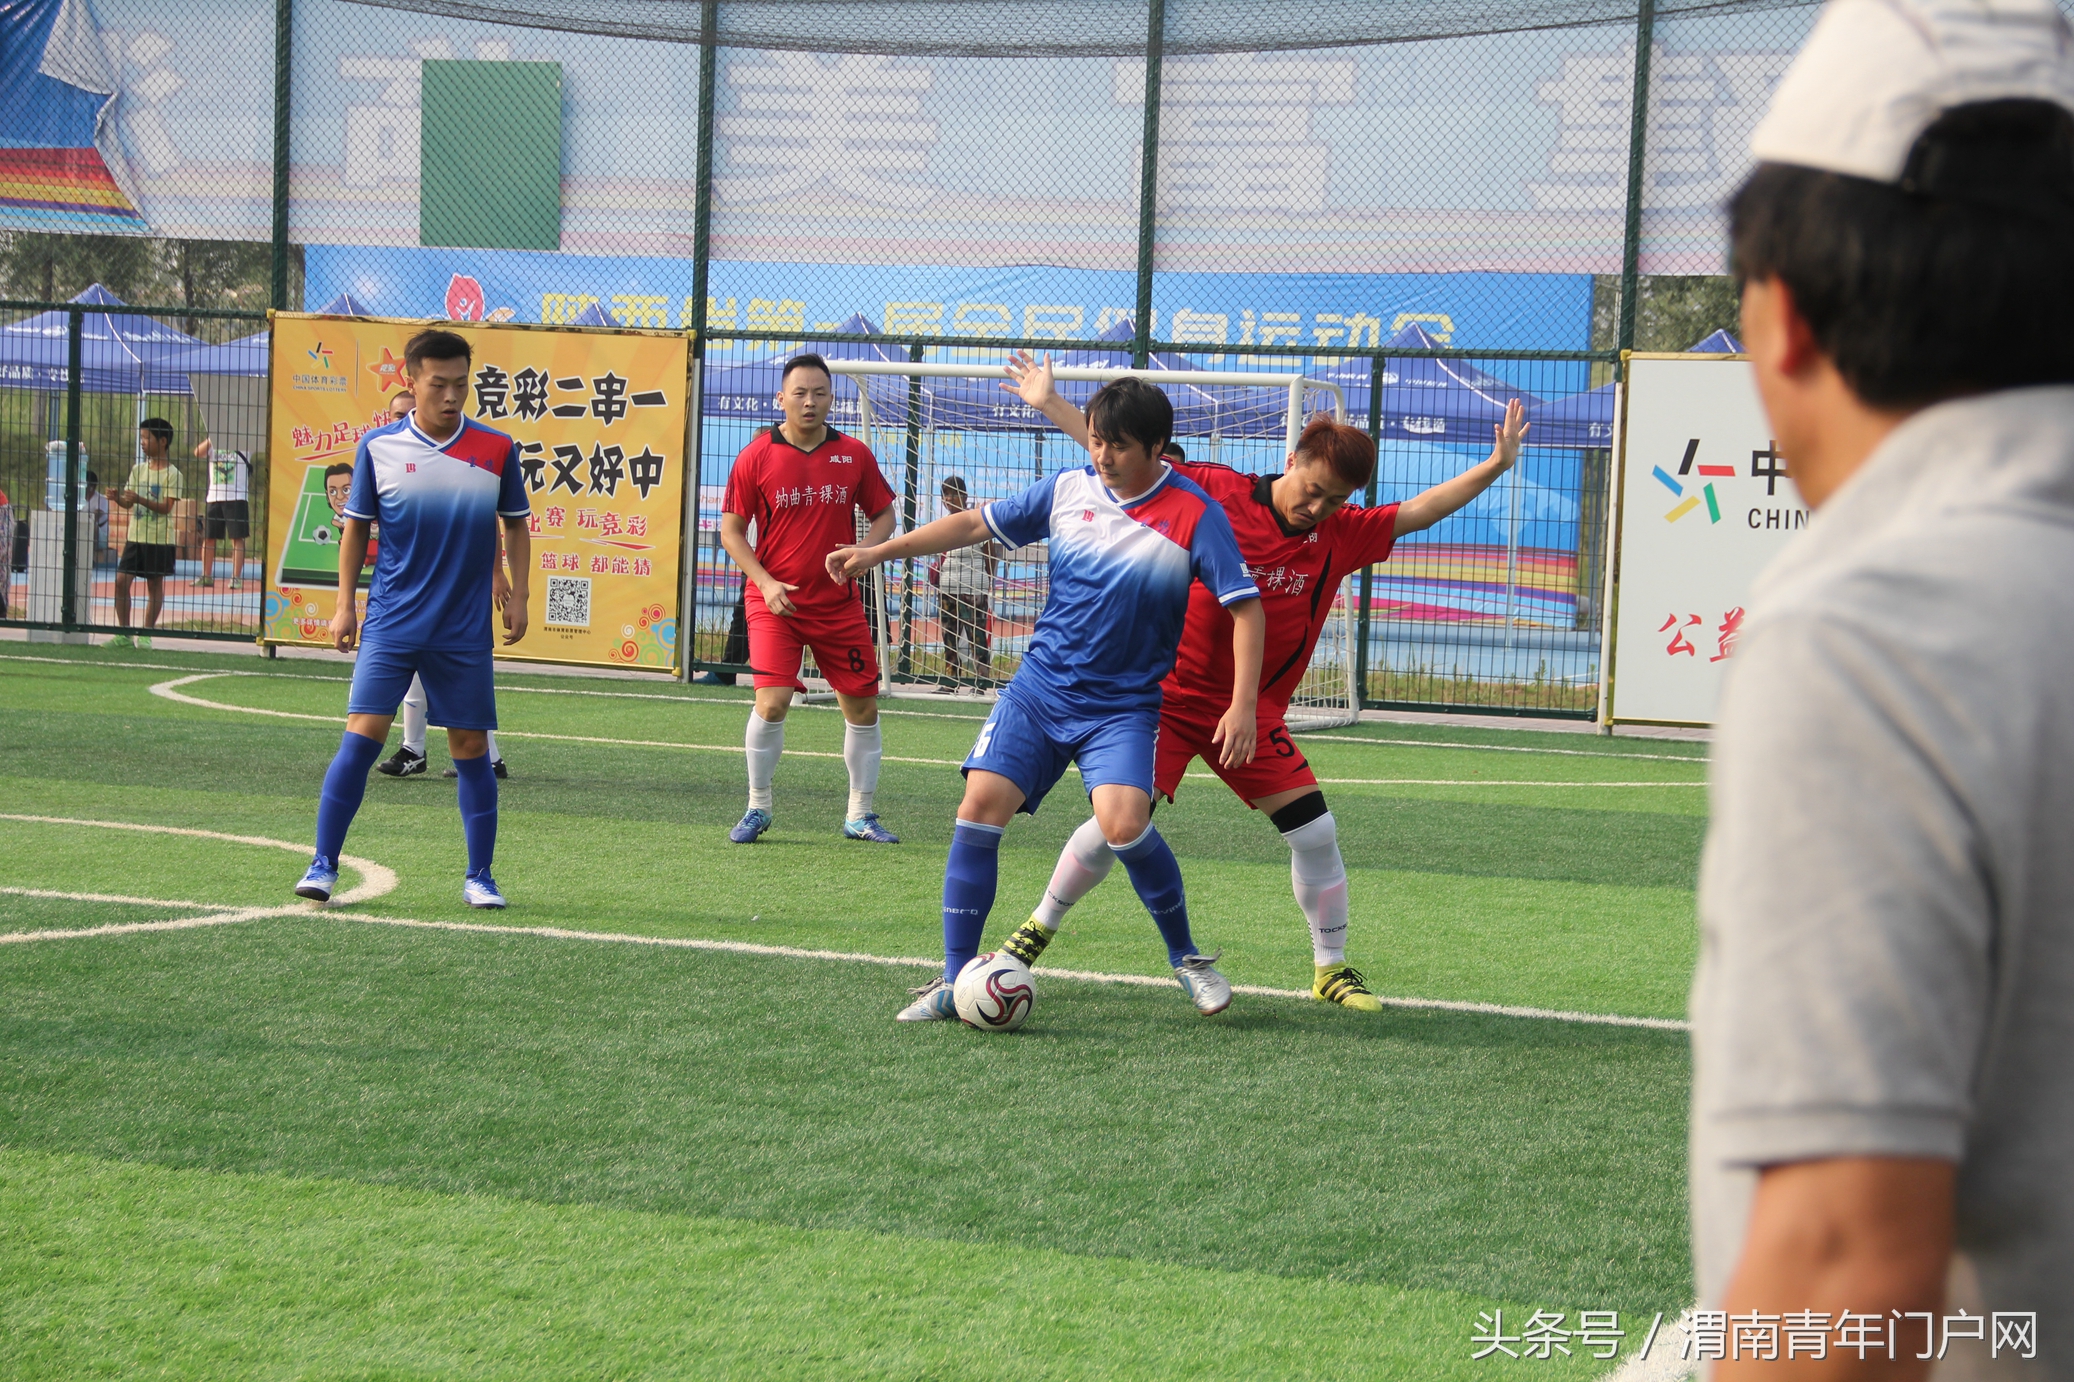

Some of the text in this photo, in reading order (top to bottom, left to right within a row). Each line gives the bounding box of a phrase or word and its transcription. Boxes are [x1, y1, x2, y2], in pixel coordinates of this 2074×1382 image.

[292, 374, 347, 386] 中国体育彩票
[473, 364, 668, 427] 竞彩二串一
[775, 484, 849, 509] 纳曲青稞酒
[576, 508, 648, 538] 玩竞彩
[540, 551, 652, 576] 篮球 都能猜
[847, 647, 866, 673] 8
[973, 722, 997, 759] 6
[1269, 725, 1295, 758] 5
